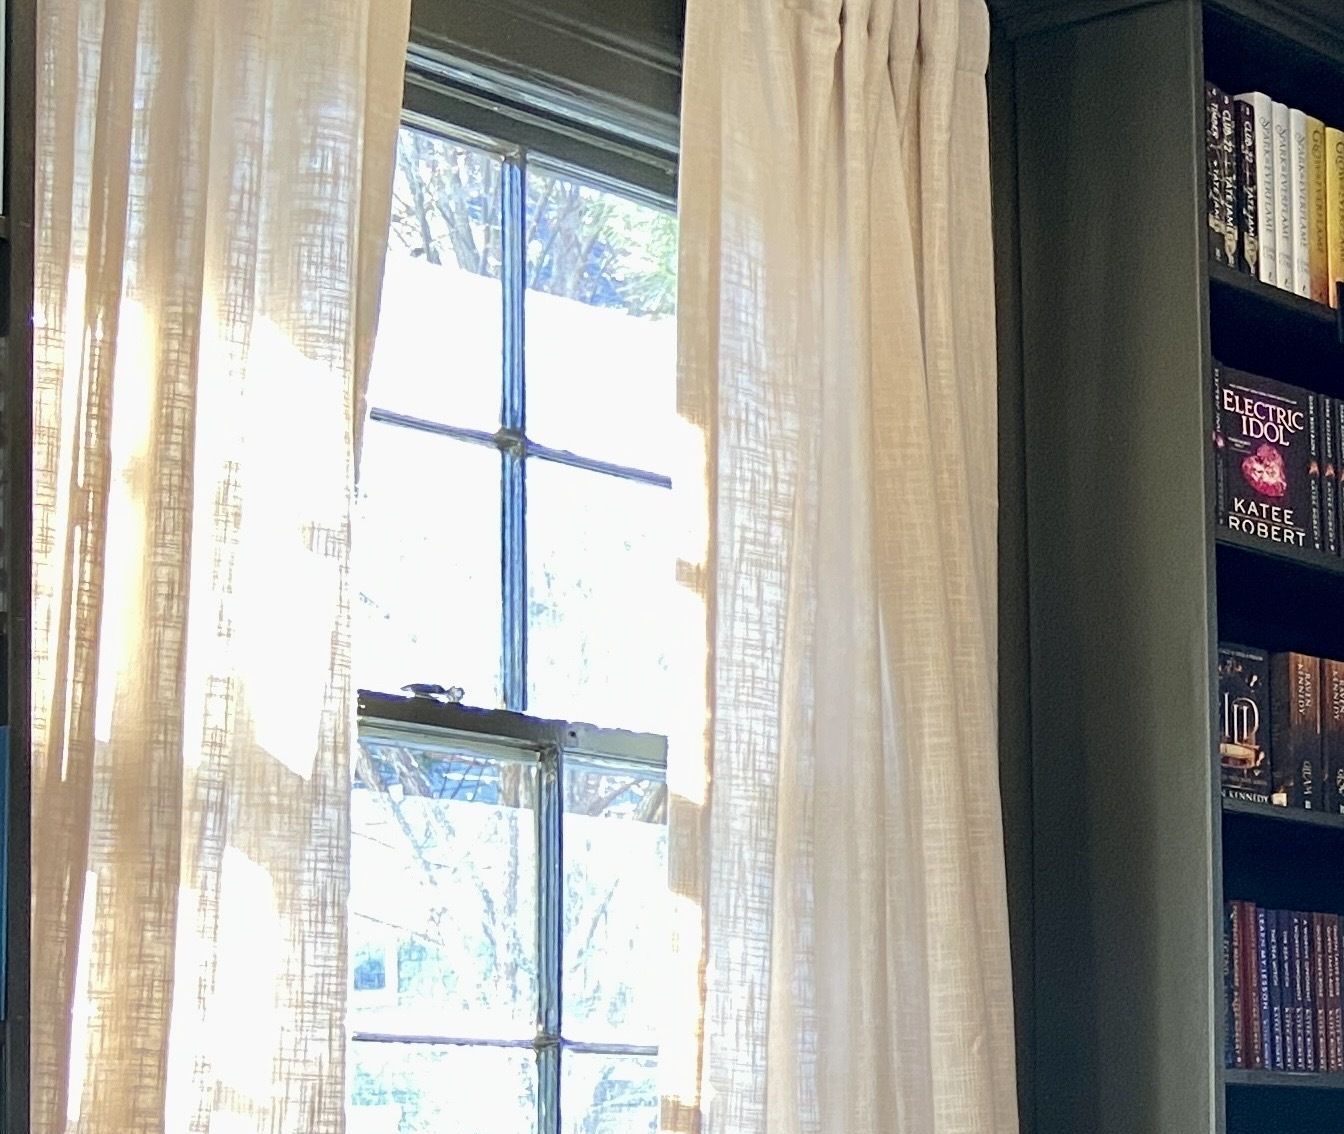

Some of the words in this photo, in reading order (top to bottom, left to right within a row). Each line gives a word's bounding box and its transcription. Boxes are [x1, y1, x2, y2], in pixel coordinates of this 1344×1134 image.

[1222, 389, 1304, 433] ELECTRIC
[1242, 415, 1290, 446] IDOL
[1234, 497, 1294, 526] KATEE
[1228, 515, 1305, 547] ROBERT
[1228, 791, 1269, 803] KENNEDY
